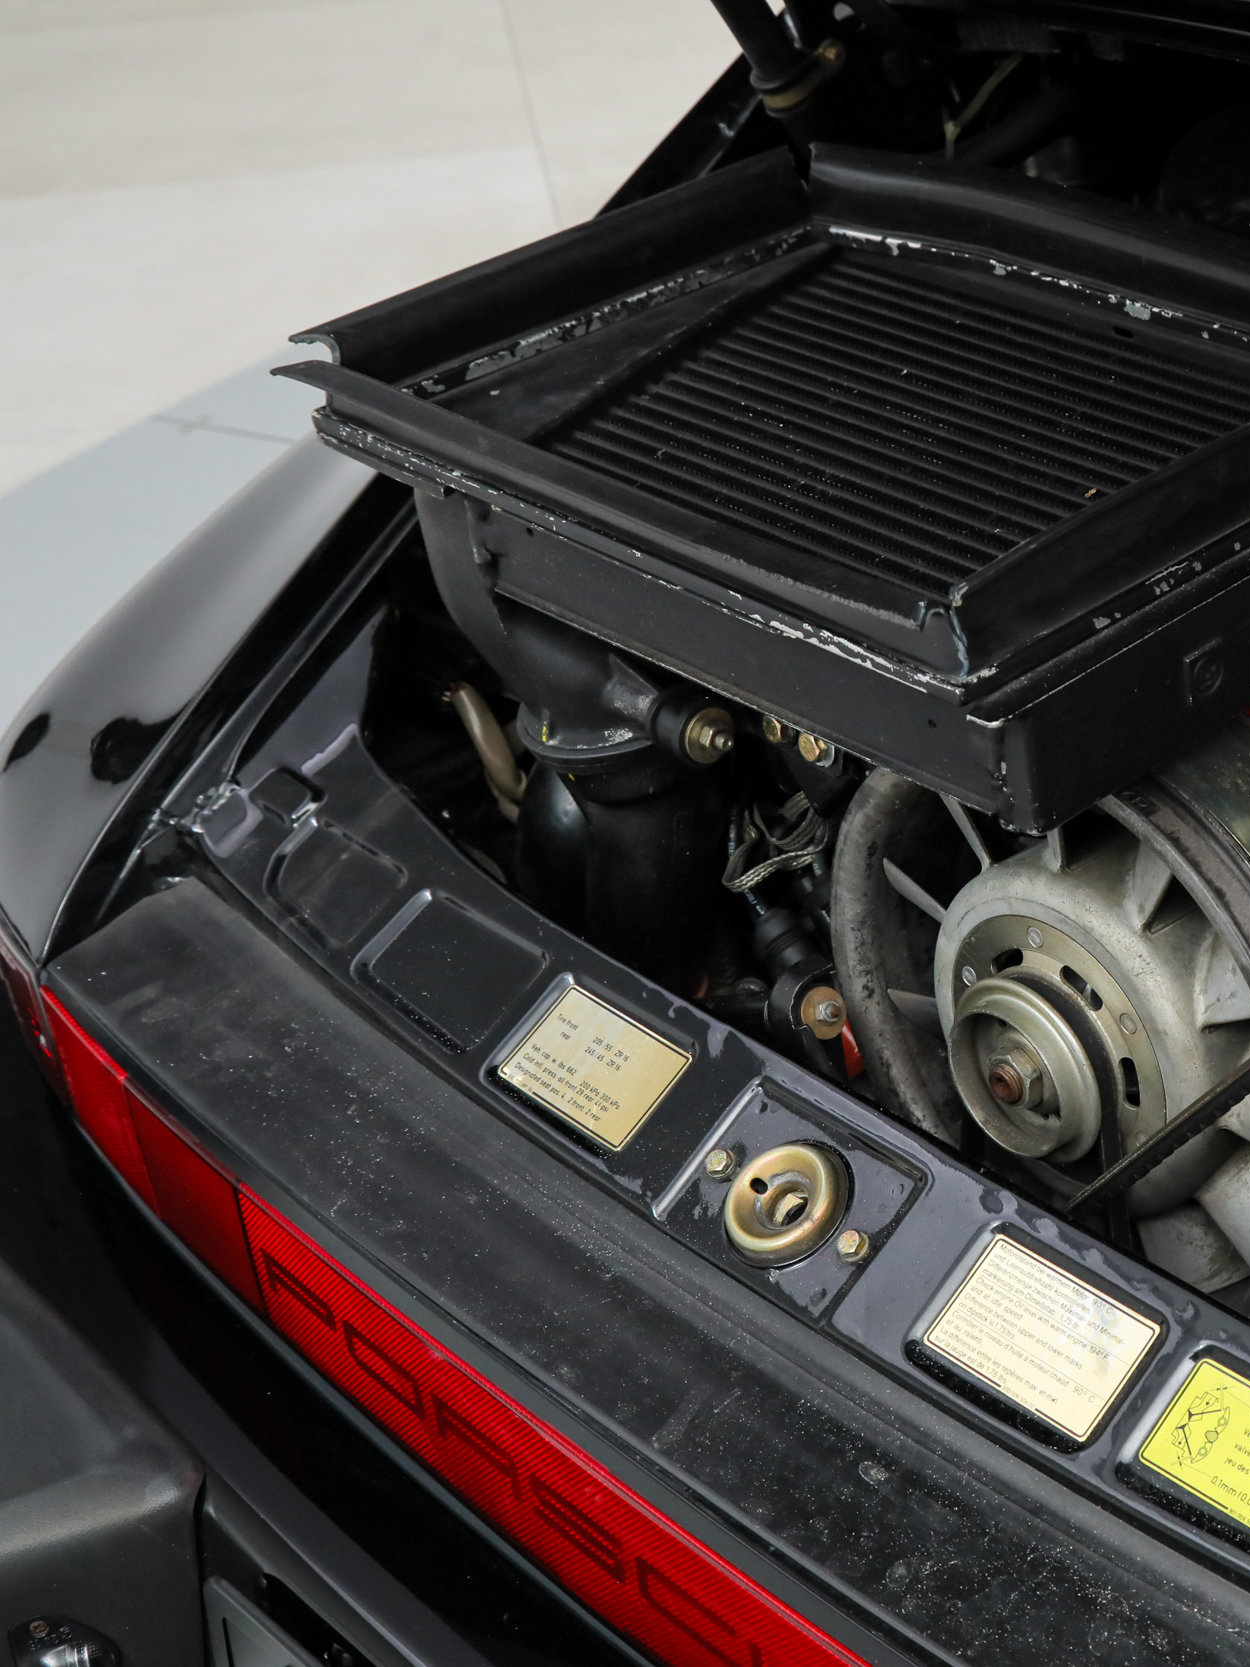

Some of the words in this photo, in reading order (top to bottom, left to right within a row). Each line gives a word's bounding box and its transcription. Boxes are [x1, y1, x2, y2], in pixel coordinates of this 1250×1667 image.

[558, 1013, 567, 1024] Tire
[566, 1020, 579, 1031] front
[560, 1031, 572, 1040] rear
[514, 1061, 542, 1083] Designated
[539, 1079, 552, 1090] seat
[589, 1112, 601, 1122] rear
[522, 1052, 536, 1064] Cold
[557, 1076, 566, 1084] all
[564, 1080, 578, 1092] front
[575, 1087, 585, 1096] 29
[582, 1093, 595, 1103] rear
[599, 1104, 609, 1113] psi
[579, 1080, 591, 1091] 200
[589, 1086, 600, 1097] kPa
[599, 1093, 611, 1103] 300
[609, 1099, 621, 1110] kPa
[958, 1301, 968, 1310] on
[966, 1306, 988, 1323] dipstick
[969, 1285, 983, 1296] and
[982, 1293, 991, 1301] at
[990, 1298, 1003, 1308] idle
[975, 1276, 994, 1291] Check
[993, 1289, 1015, 1304] engine
[1022, 1306, 1039, 1318] level
[1037, 1316, 1050, 1326] with
[1049, 1323, 1067, 1336] warm
[1066, 1333, 1088, 1349] engine
[953, 1324, 963, 1333] au
[964, 1292, 994, 1315] Difference
[992, 1310, 1018, 1329] between
[1017, 1327, 1036, 1340] upper
[1034, 1337, 1049, 1348] and
[1047, 1343, 1064, 1357] lower
[1063, 1355, 1083, 1370] marks
[934, 1335, 945, 1344] sur
[949, 1345, 967, 1359] jauge
[966, 1356, 978, 1364] est
[976, 1361, 985, 1370] de
[939, 1326, 949, 1336] La
[976, 1350, 992, 1363] entre
[991, 1359, 1002, 1369] les
[1038, 1389, 1047, 1397] et
[978, 1326, 985, 1335] le
[984, 1331, 1004, 1347] niveau
[1028, 1359, 1050, 1374] moteur
[268, 1254, 764, 1667] PORSC
[1223, 1457, 1237, 1468] jeu
[1236, 1463, 1250, 1475] des
